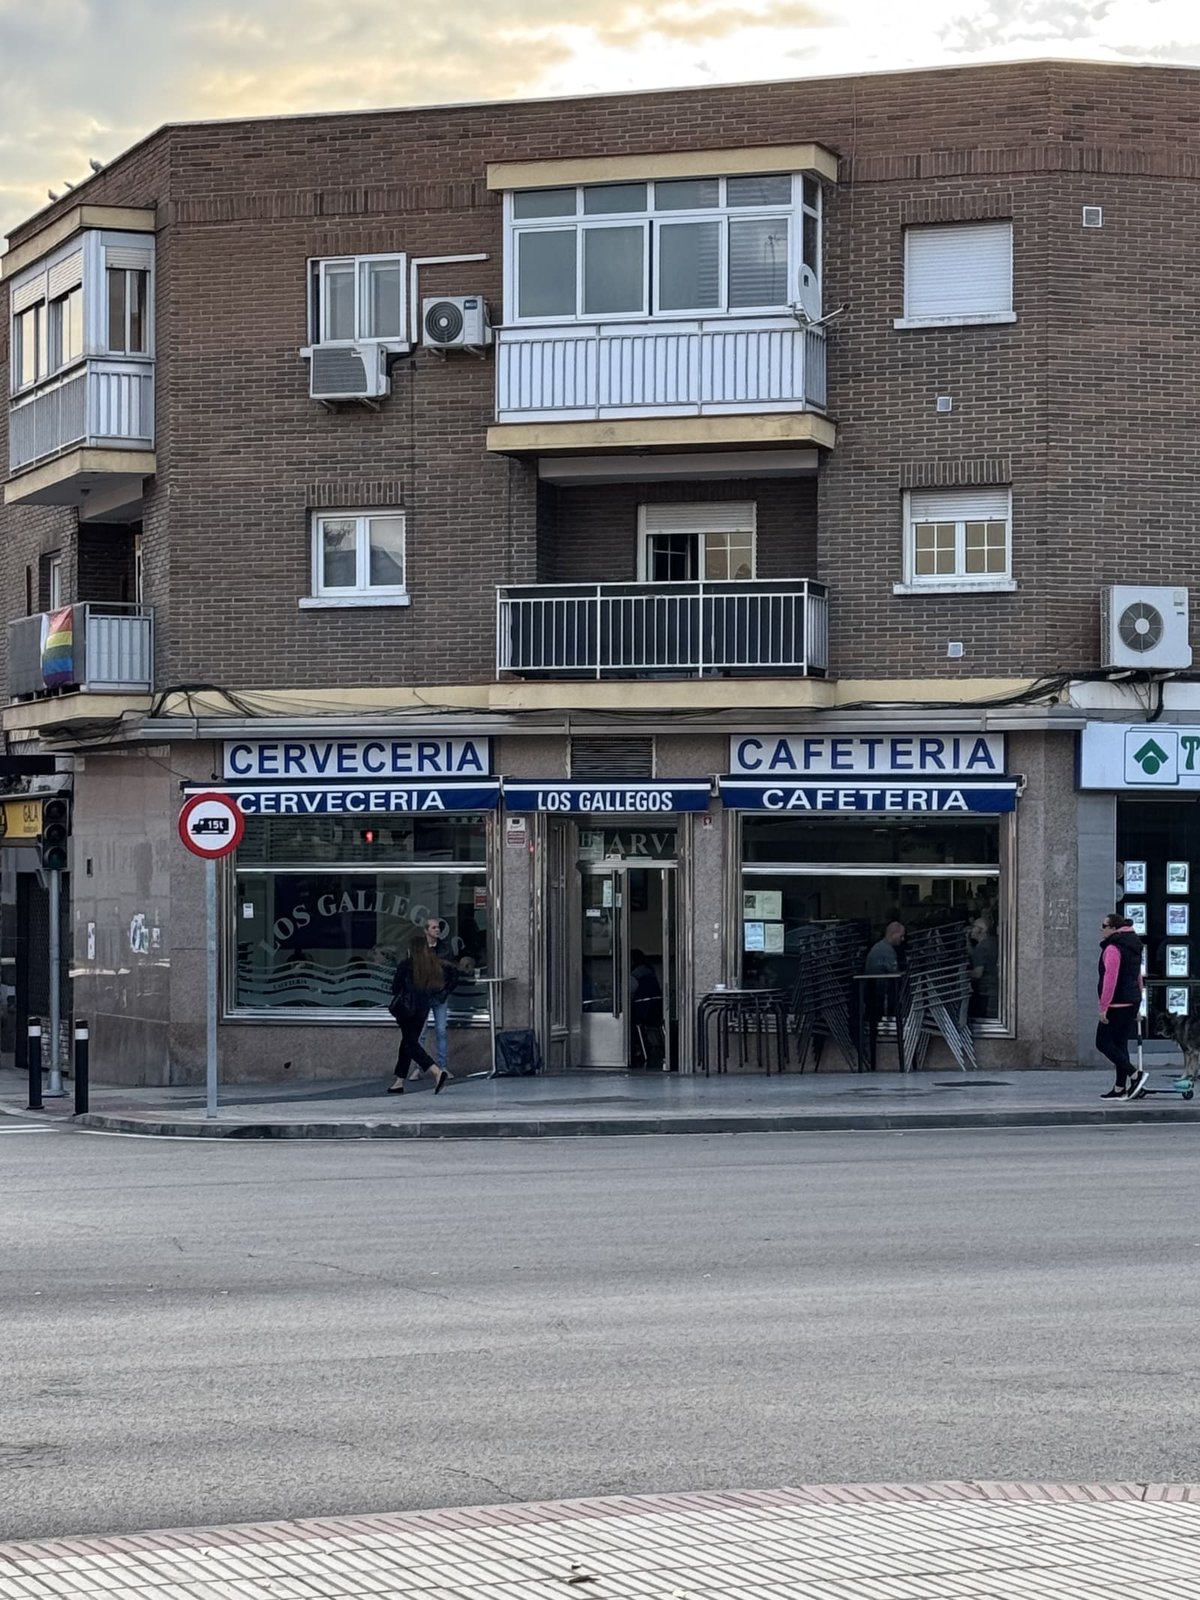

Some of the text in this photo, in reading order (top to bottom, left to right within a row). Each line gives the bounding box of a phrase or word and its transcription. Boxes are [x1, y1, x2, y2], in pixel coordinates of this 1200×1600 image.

[229, 741, 484, 775] CERVECERIA
[737, 737, 996, 770] CAFETERIA
[236, 790, 446, 814] CERVECERIA
[537, 791, 673, 811] LOS GALLEGOS
[762, 789, 969, 811] CAFETERIA
[207, 820, 225, 830] 15t
[258, 904, 311, 957] LOS
